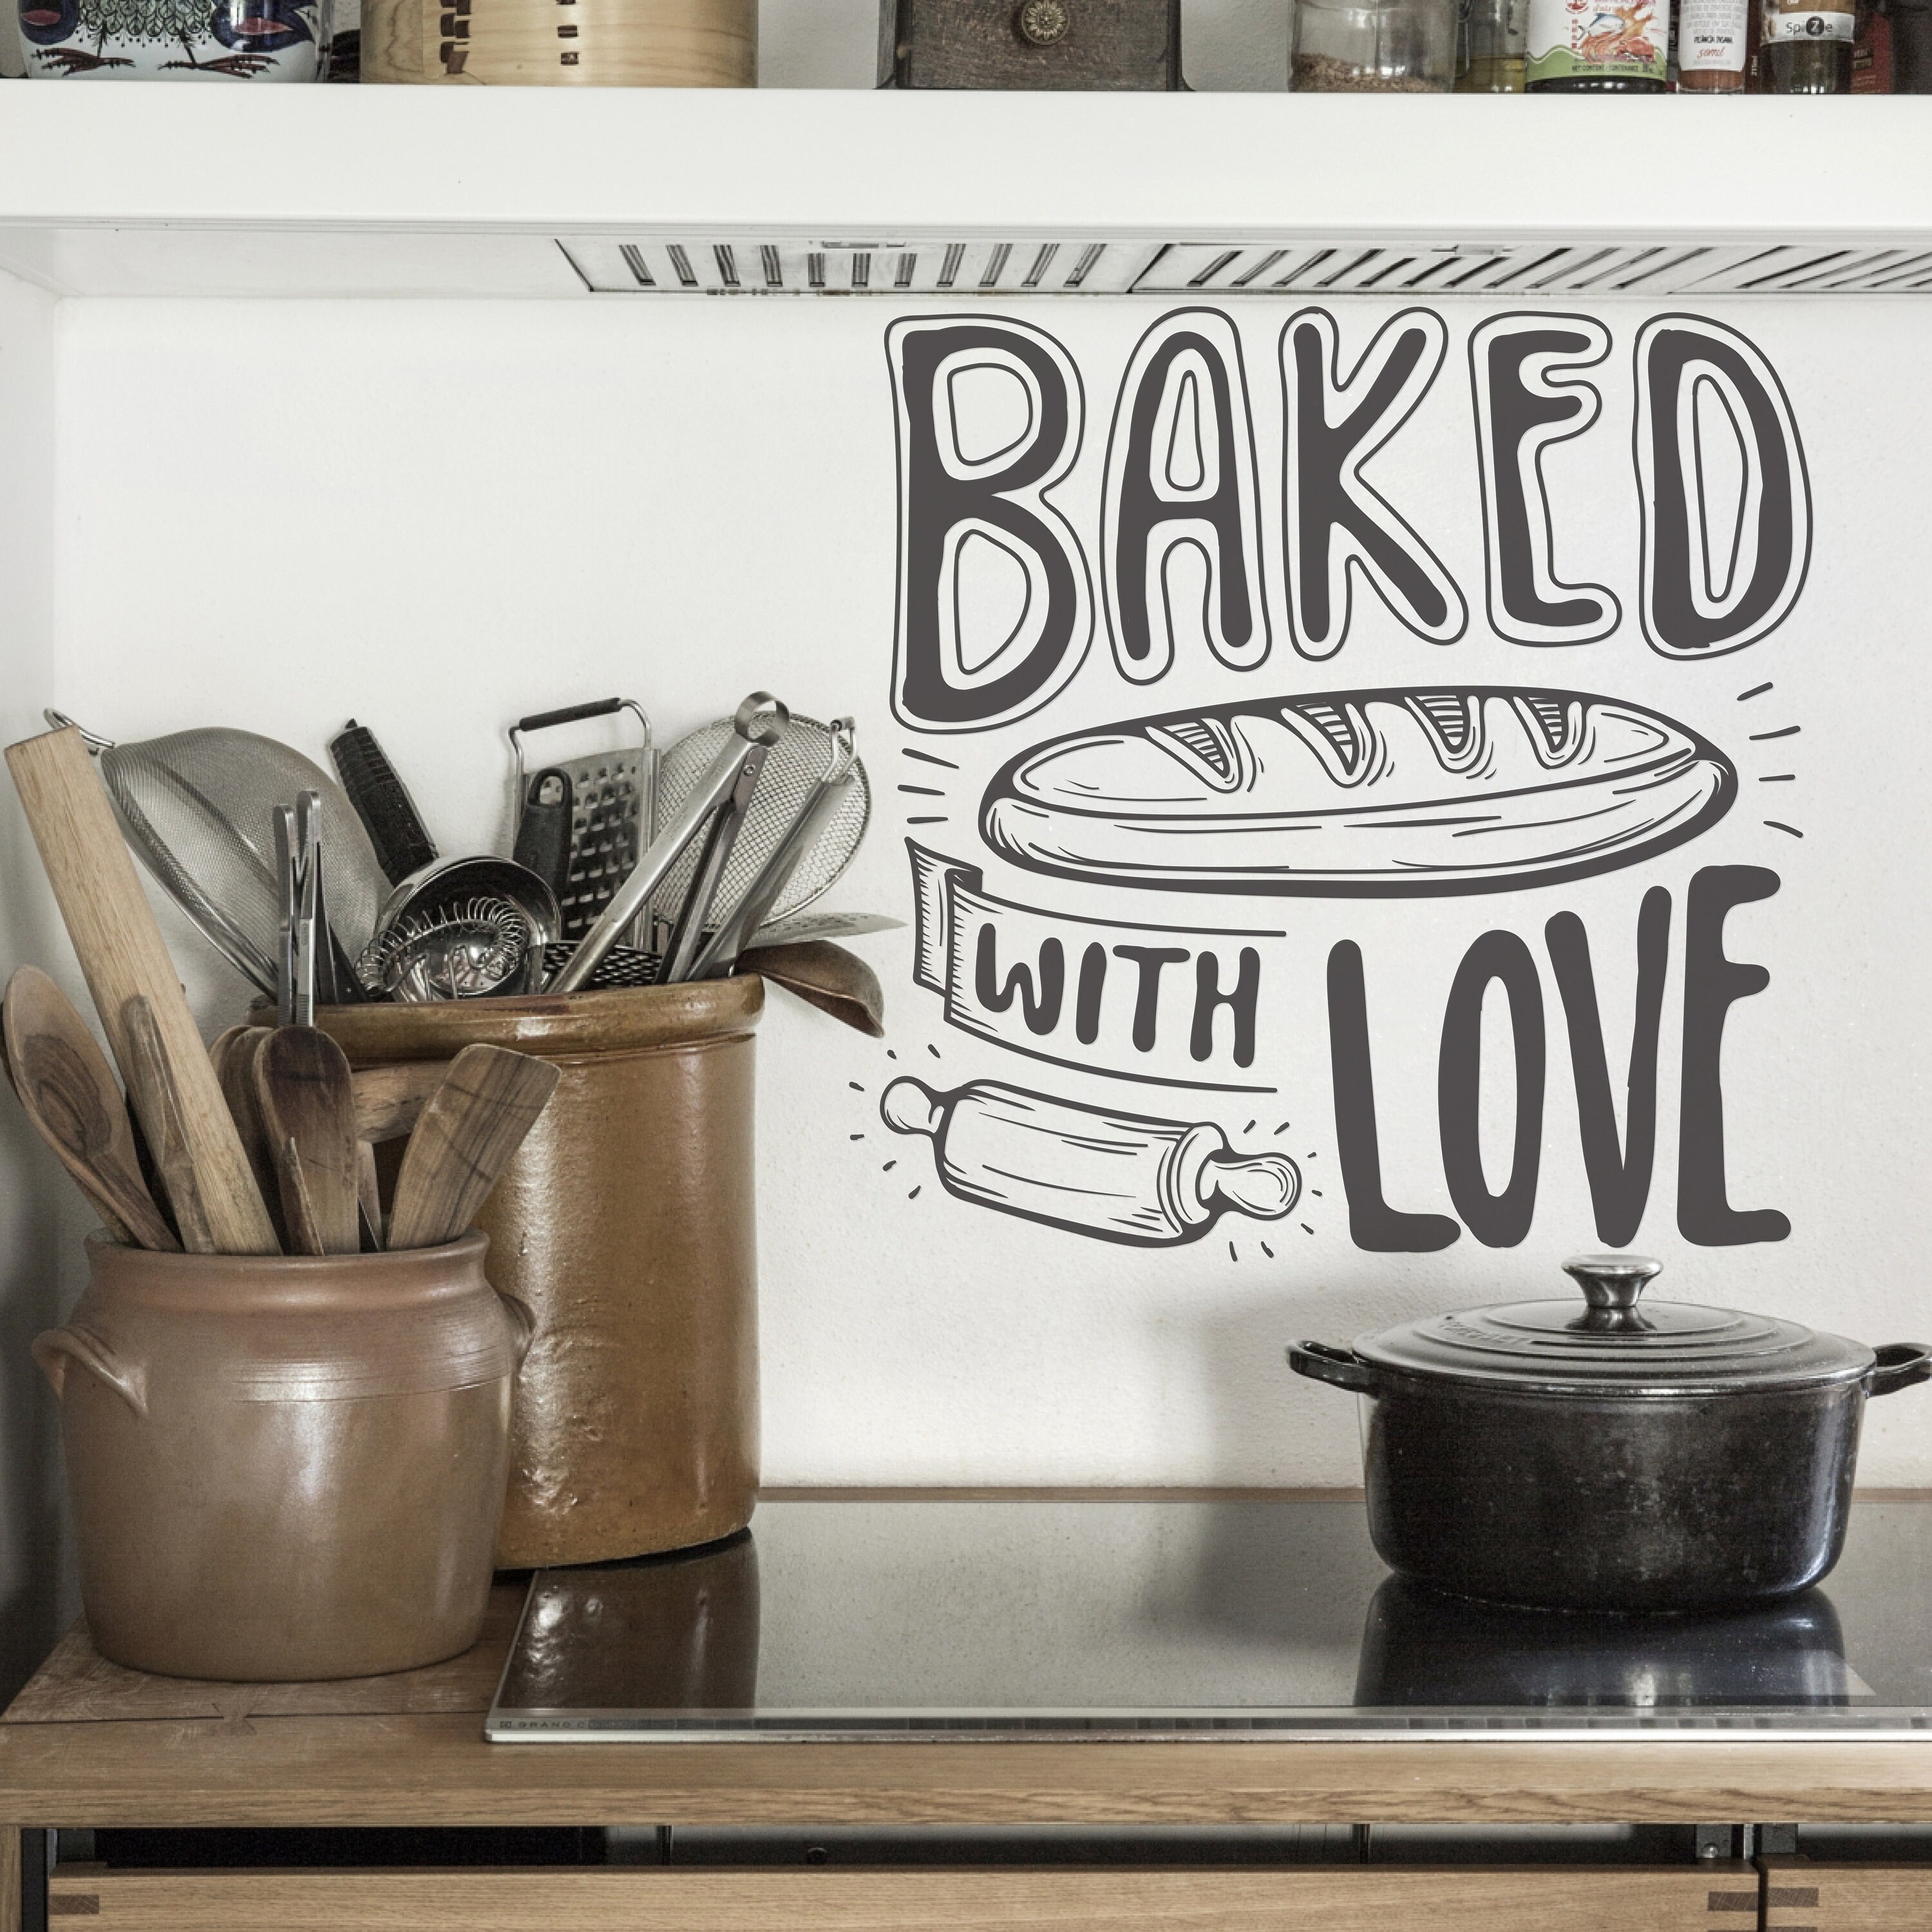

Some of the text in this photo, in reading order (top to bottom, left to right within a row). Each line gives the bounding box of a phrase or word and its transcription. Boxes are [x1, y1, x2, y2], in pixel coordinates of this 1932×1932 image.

[884, 307, 1813, 734] BAKED
[975, 864, 1792, 1253] WITH LOVE
